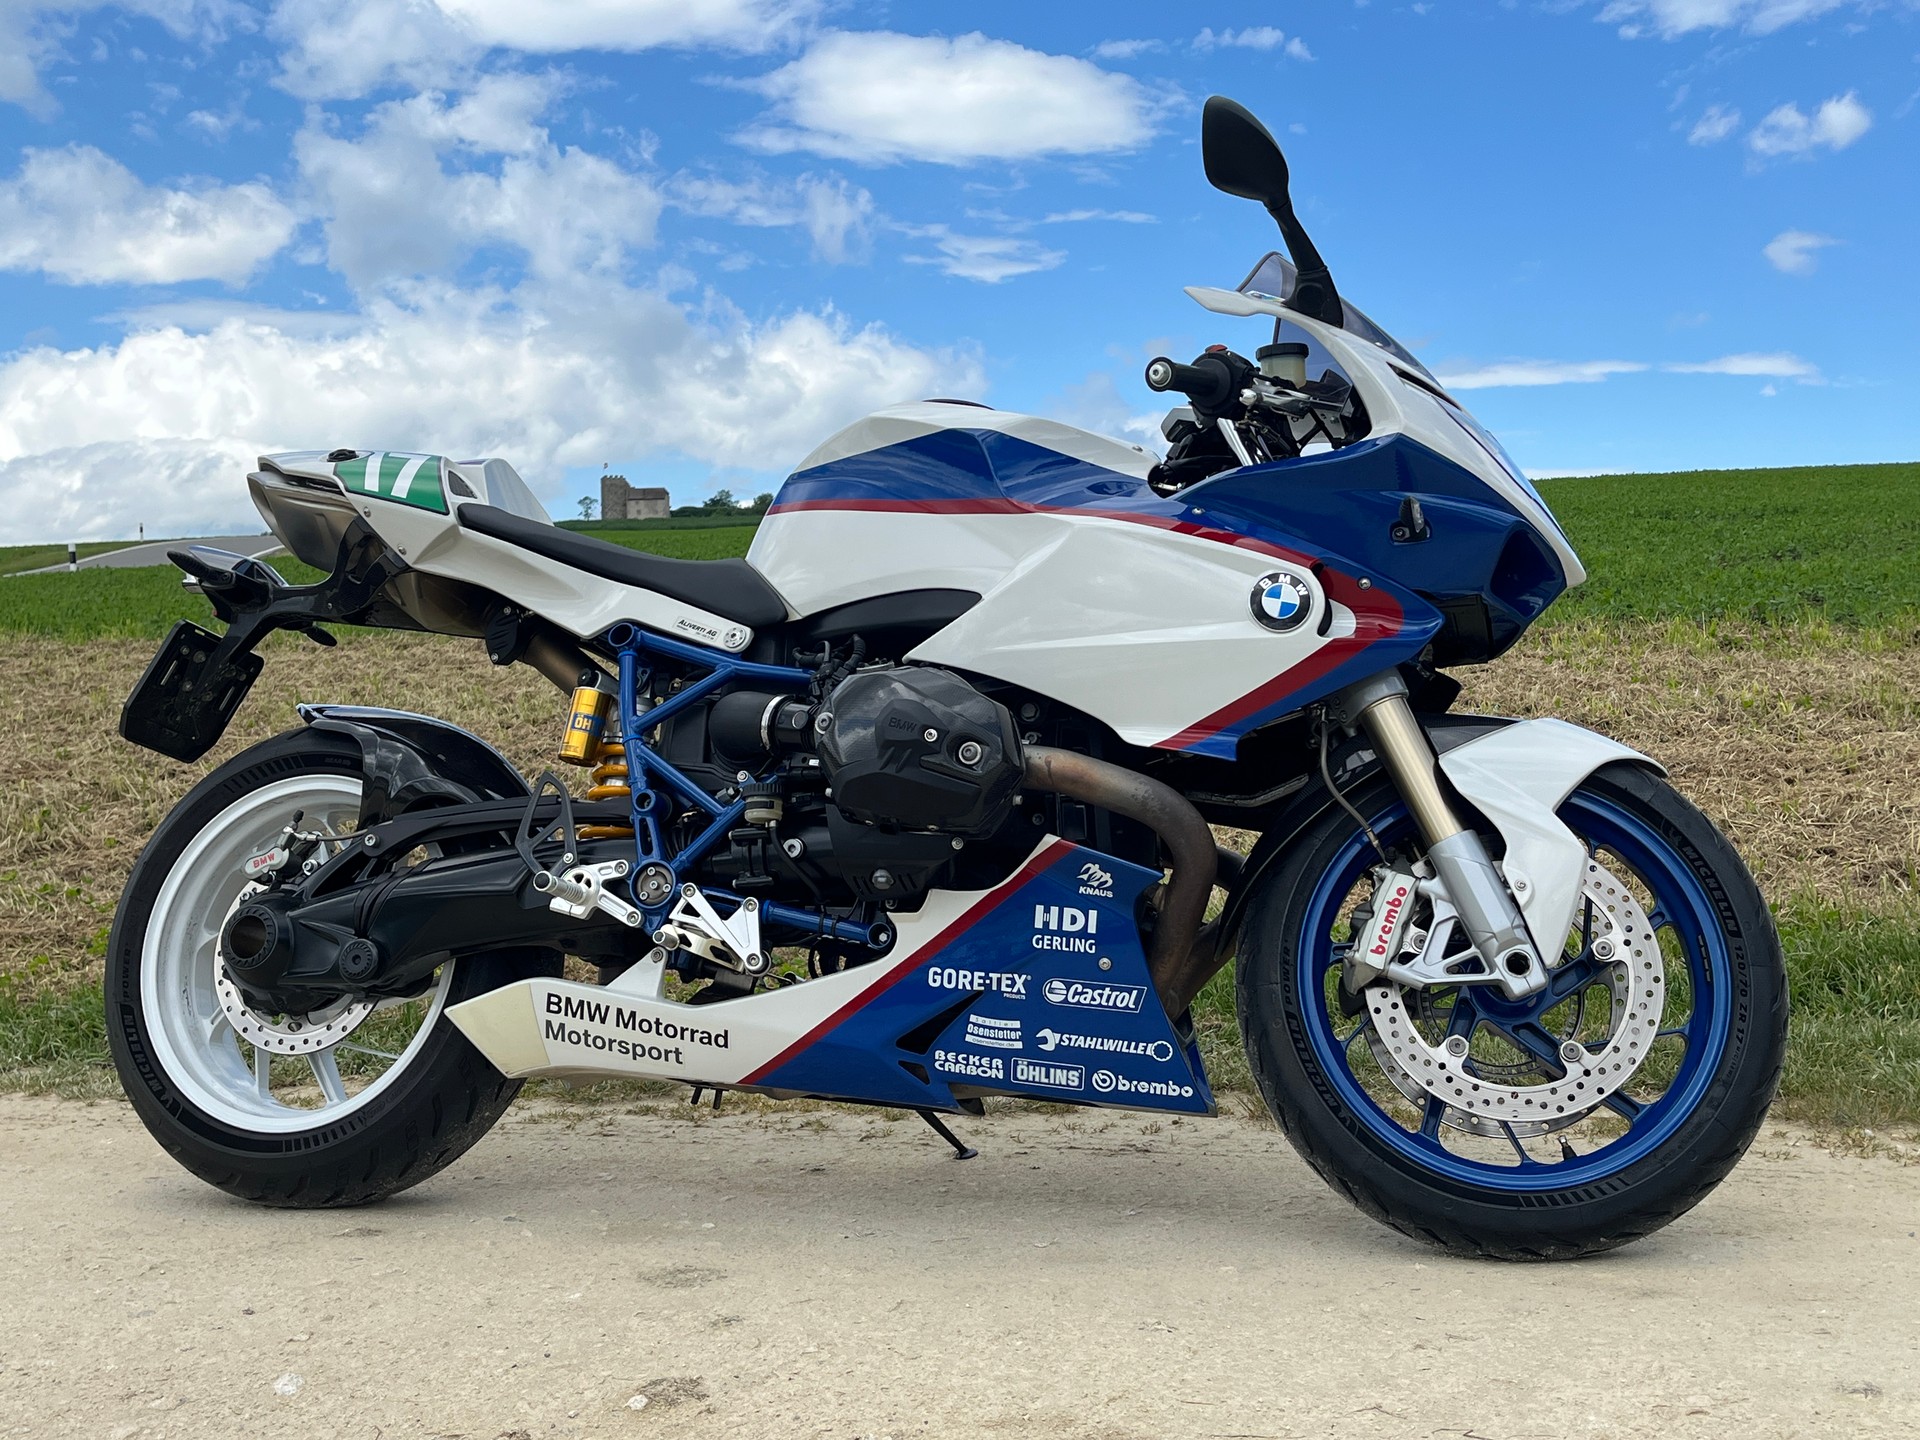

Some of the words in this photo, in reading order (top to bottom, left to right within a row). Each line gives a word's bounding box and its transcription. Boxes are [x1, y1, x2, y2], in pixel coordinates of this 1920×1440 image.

[364, 451, 432, 499] 17
[1258, 574, 1308, 596] BMW
[888, 717, 917, 732] BMW
[253, 852, 275, 869] BMW
[1079, 886, 1113, 898] KNAUS
[1682, 845, 1738, 932] MICHELIN
[1034, 904, 1097, 934] HDI
[1370, 886, 1407, 956] brembo
[1032, 934, 1096, 954] GERLING
[122, 949, 132, 998] POWER
[1282, 946, 1293, 1005] POWER
[1734, 945, 1748, 997] 120/70
[1003, 992, 1026, 1000] PRODUCTS
[1067, 984, 1139, 1008] Castrol
[545, 992, 610, 1025] BMW
[615, 1007, 729, 1049] Motorrad
[1738, 1004, 1748, 1023] ZR
[545, 1019, 684, 1065] Motorsport
[967, 1023, 1022, 1040] Osenstetter
[1735, 1028, 1745, 1044] 17
[123, 1014, 163, 1093] MICHELIN
[1060, 1033, 1147, 1056] STAHLWILLE
[934, 1050, 1004, 1069] BECKER
[934, 1060, 1004, 1079] CARBON
[1288, 1018, 1339, 1112] MICHELIN
[1016, 1060, 1081, 1087] ÖHLINS
[1118, 1075, 1193, 1097] brembo
